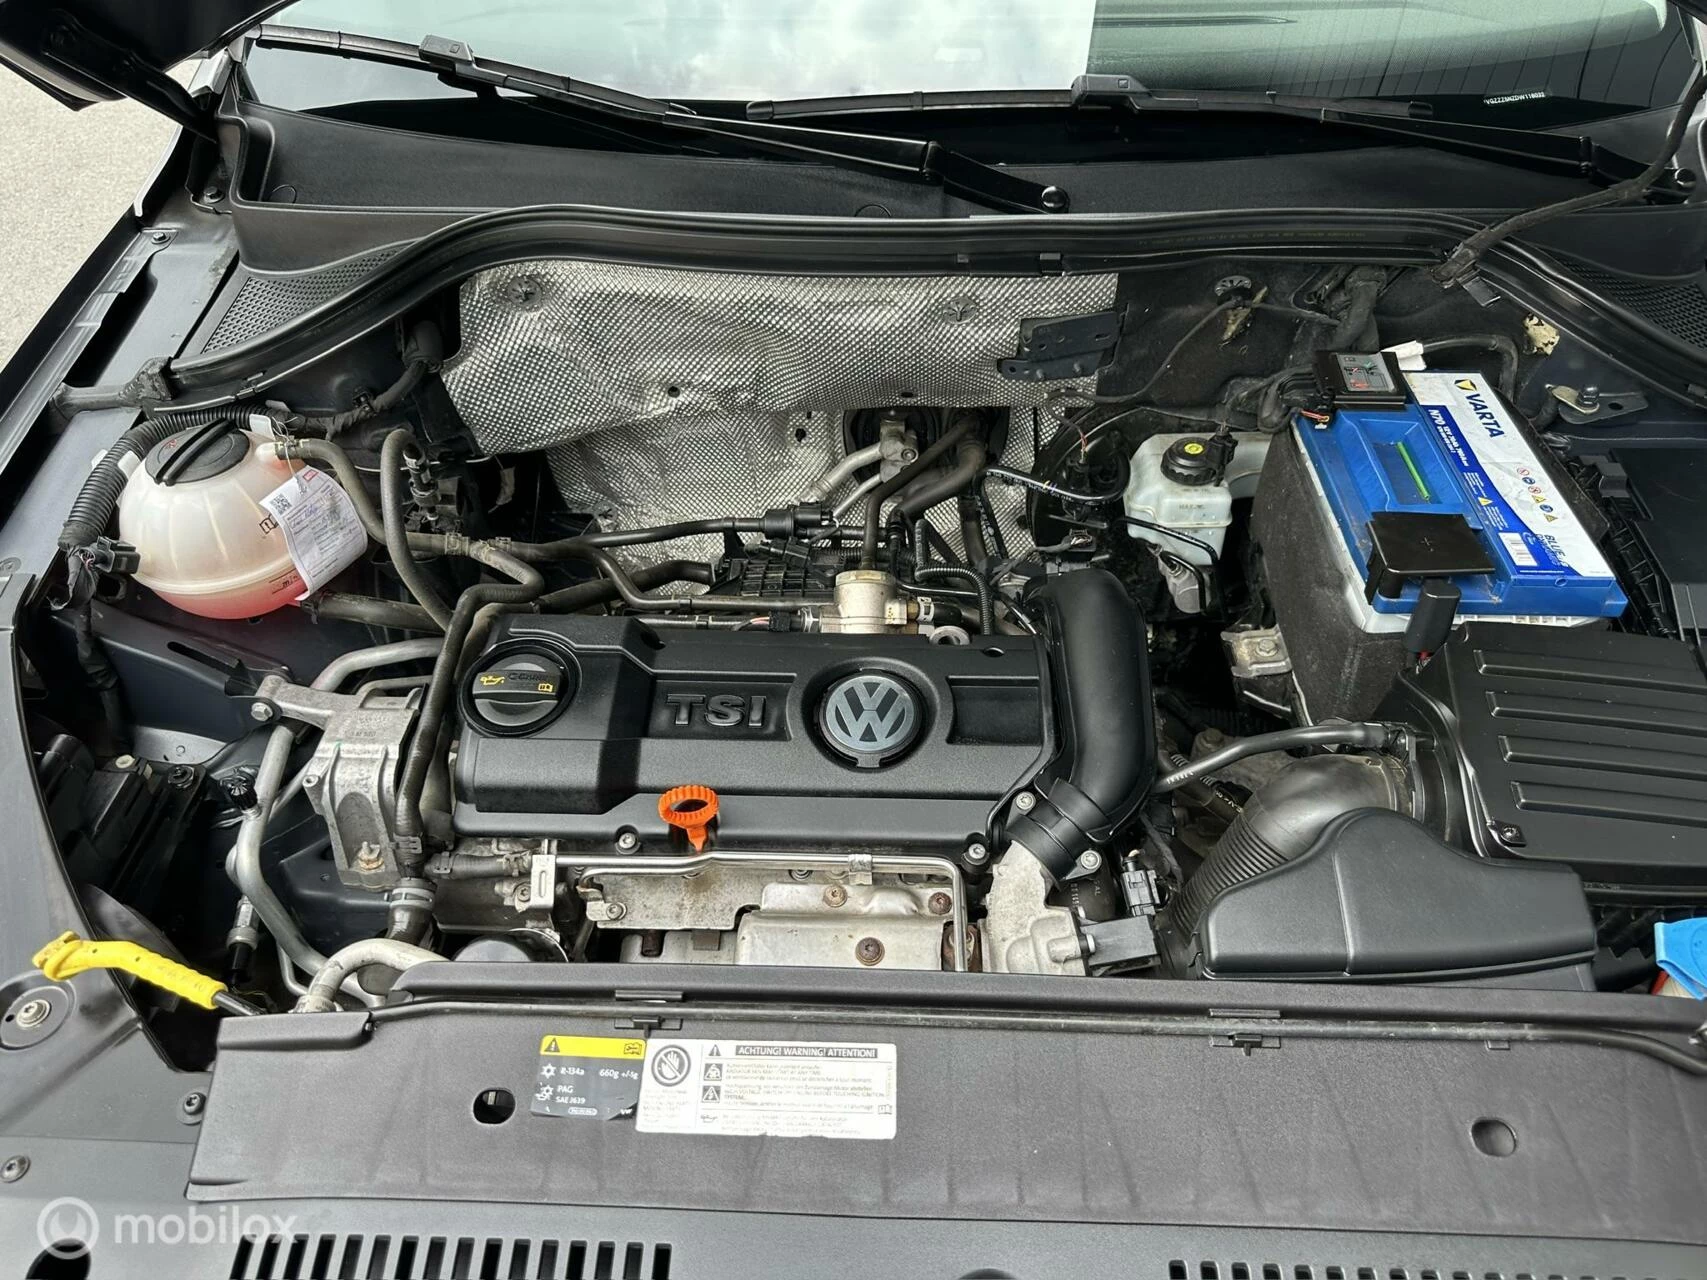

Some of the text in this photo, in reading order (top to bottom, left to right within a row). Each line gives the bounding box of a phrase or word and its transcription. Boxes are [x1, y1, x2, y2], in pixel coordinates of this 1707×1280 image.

[1428, 409, 1446, 425] N70
[1465, 393, 1505, 438] VARTA
[1544, 534, 1567, 557] BLUE
[667, 693, 768, 727] TSI
[738, 1046, 876, 1057] ACHTUNG! WARNING! ATTENTION!
[599, 1068, 620, 1080] 660g
[557, 1085, 574, 1094] PAG
[556, 1096, 569, 1104] SAE
